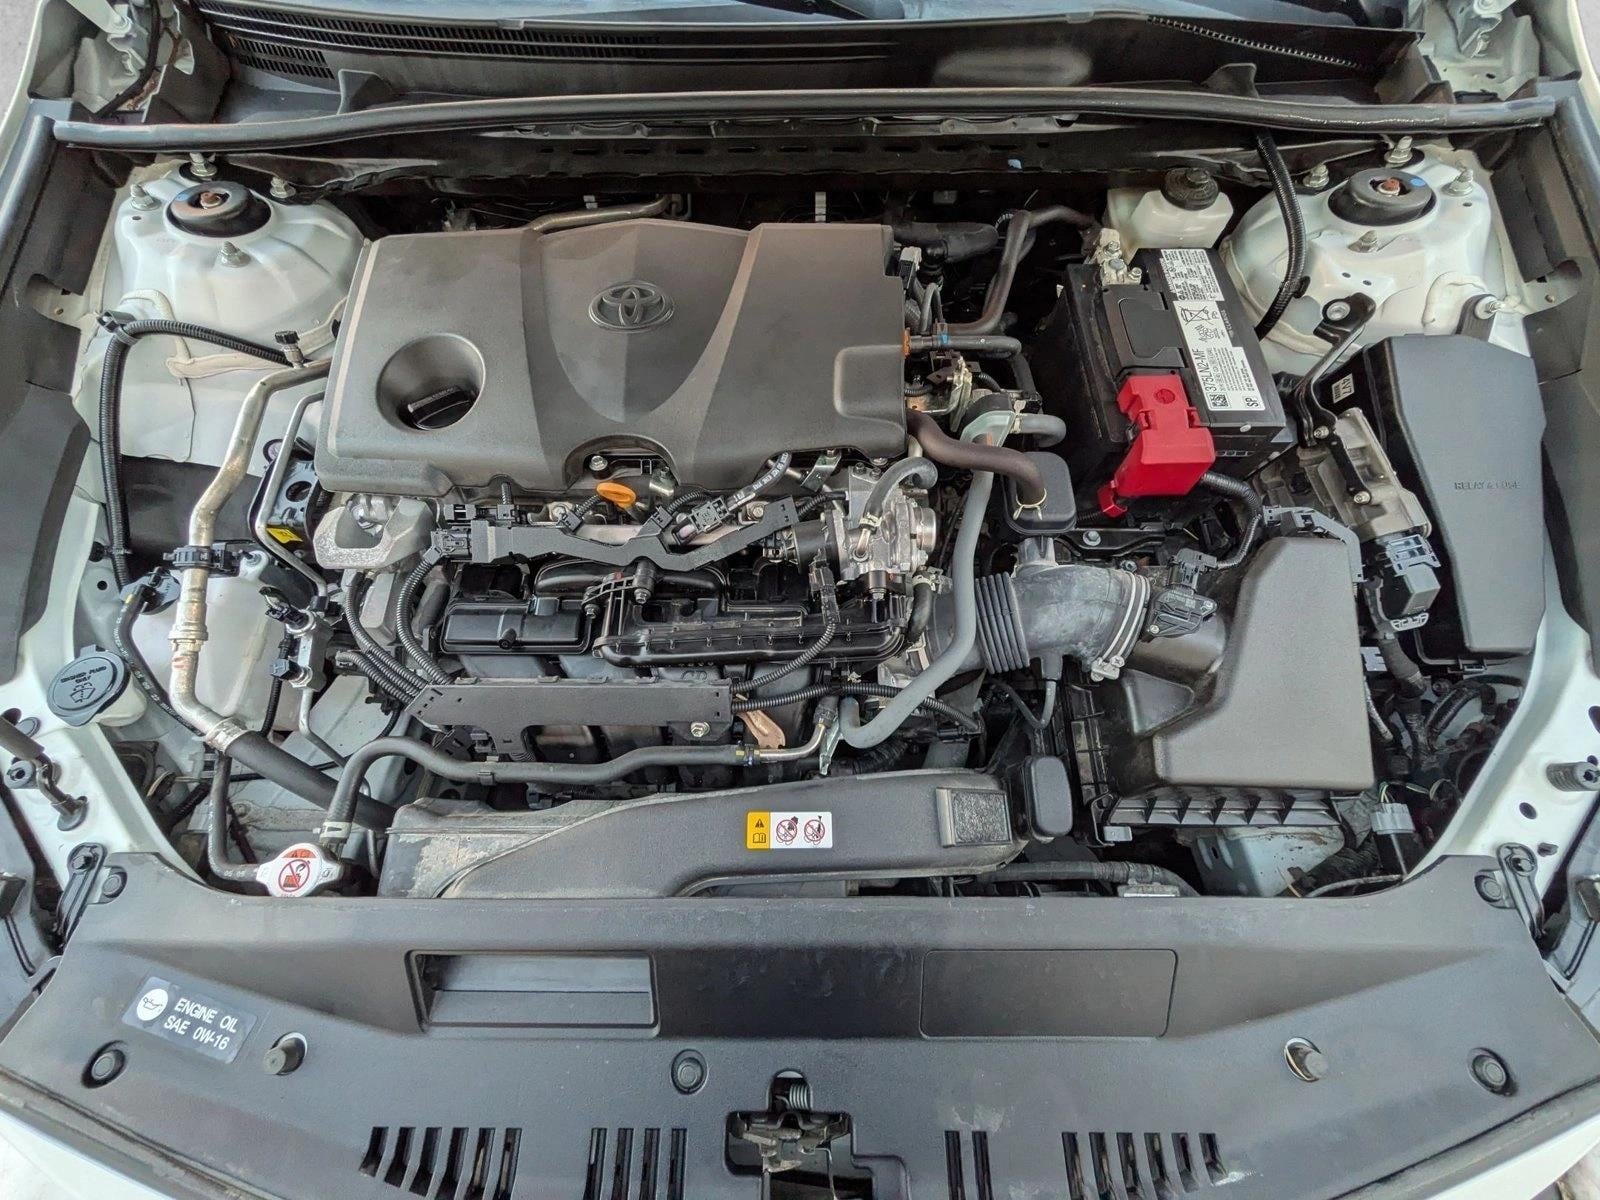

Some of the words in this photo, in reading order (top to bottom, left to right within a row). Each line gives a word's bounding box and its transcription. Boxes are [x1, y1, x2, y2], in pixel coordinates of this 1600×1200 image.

[1191, 348, 1218, 392] 375LN2-MF
[1245, 397, 1259, 407] SP
[163, 1015, 191, 1035] SAE
[192, 1026, 231, 1050] 0W-16
[174, 998, 218, 1024] ENGINE
[219, 1015, 238, 1034] OIL
